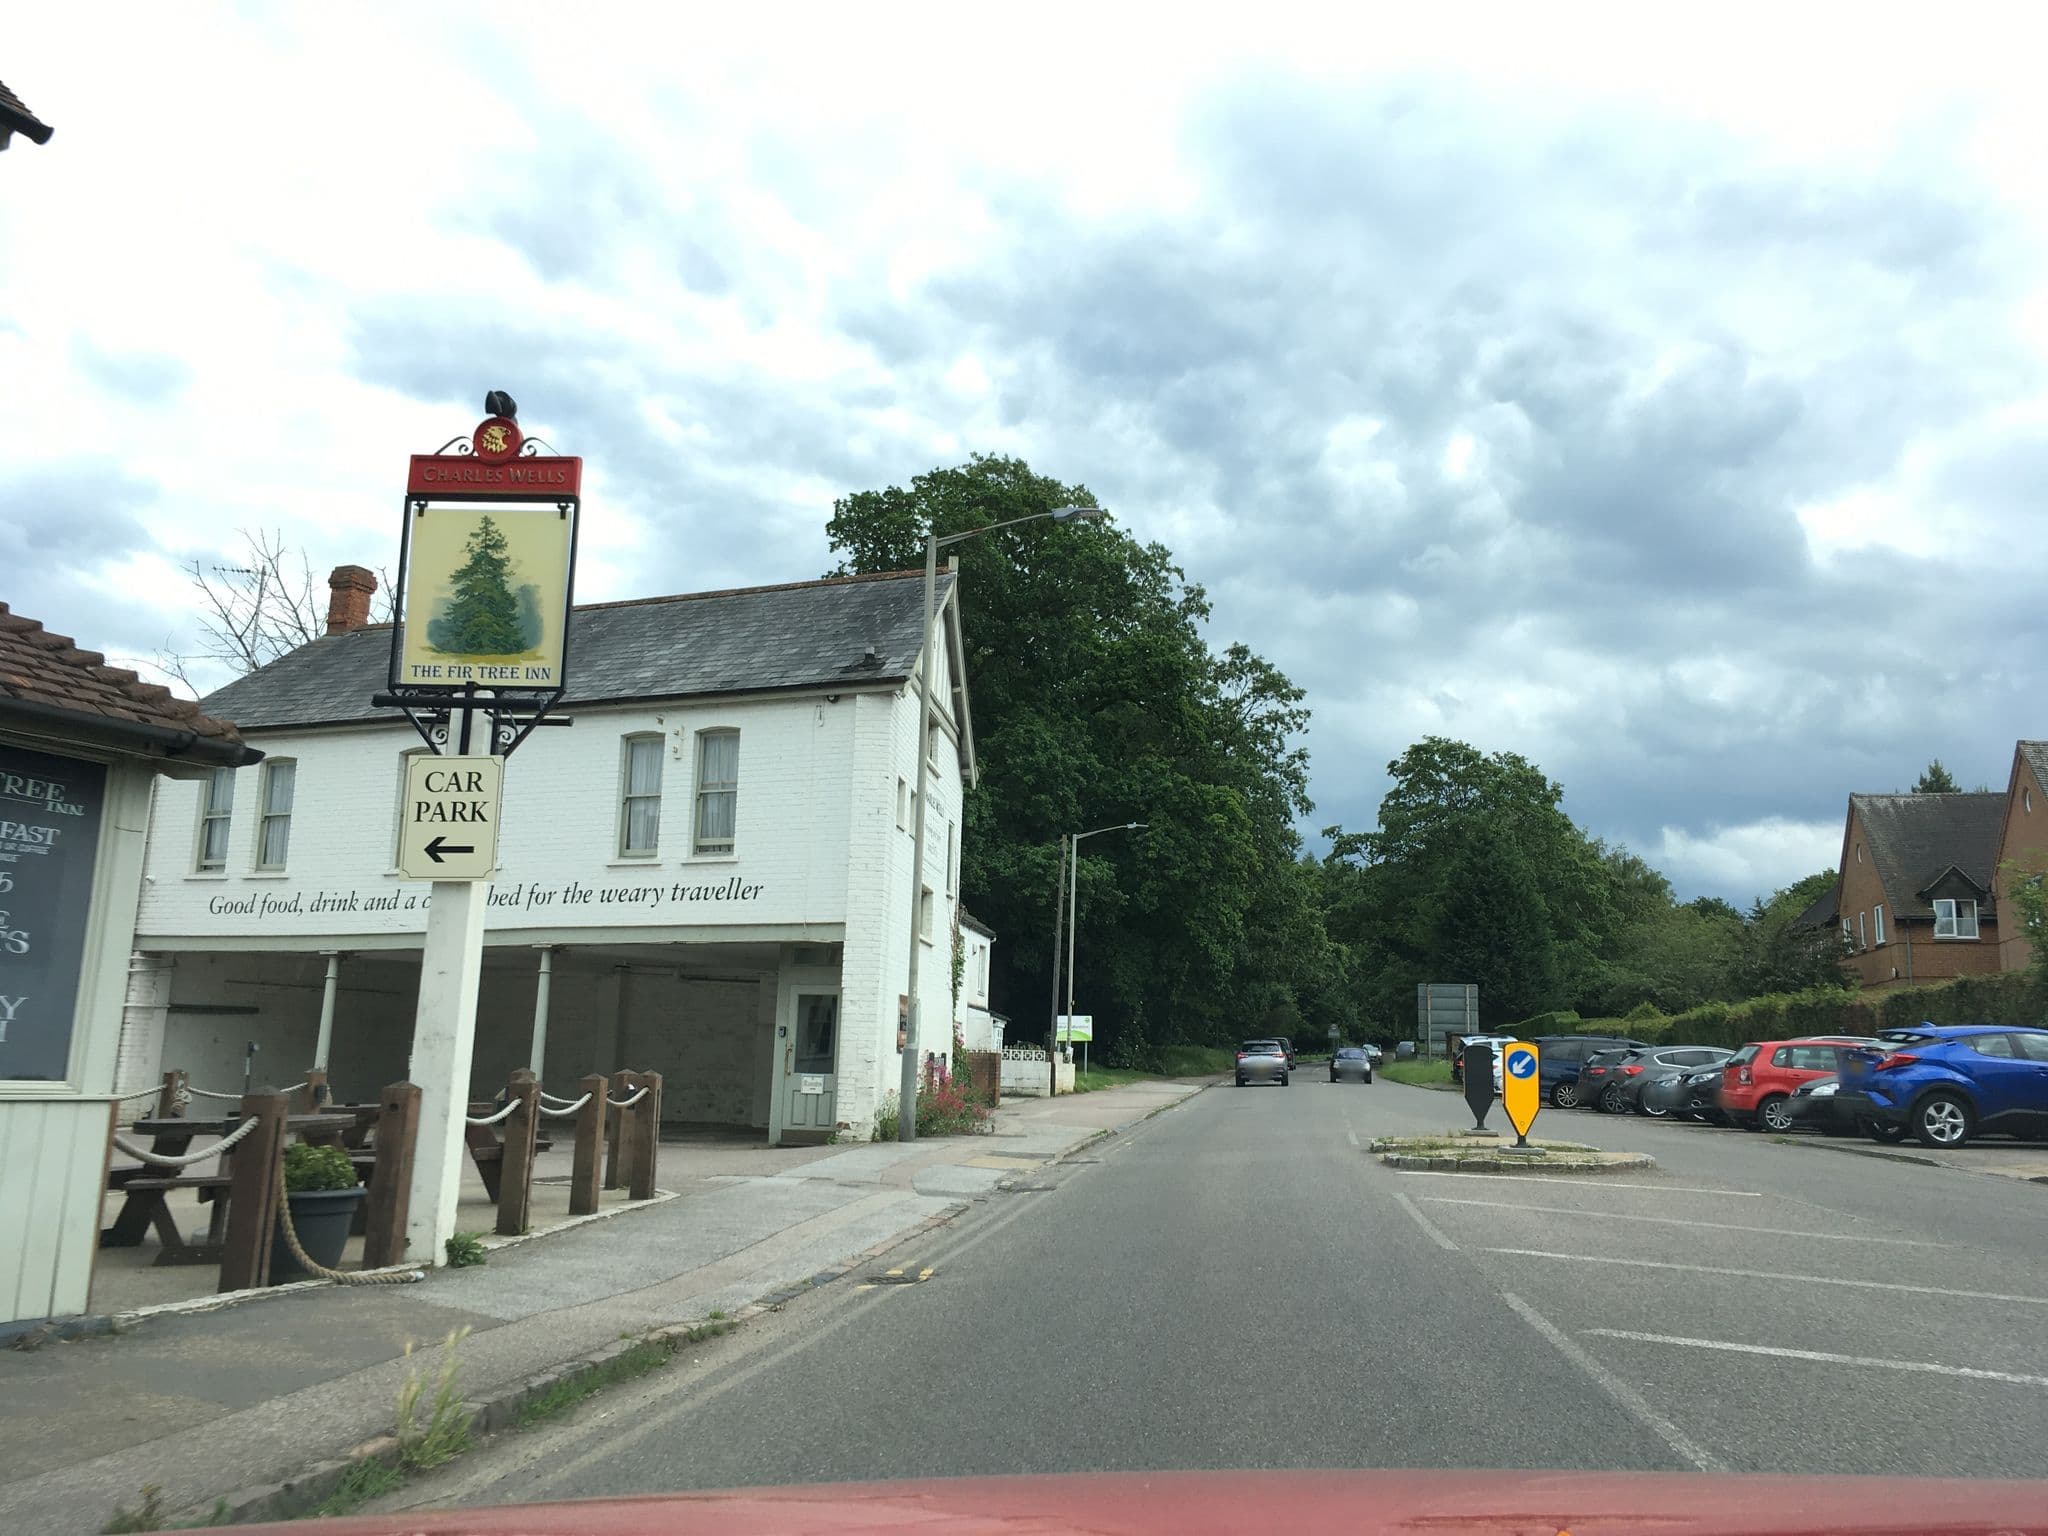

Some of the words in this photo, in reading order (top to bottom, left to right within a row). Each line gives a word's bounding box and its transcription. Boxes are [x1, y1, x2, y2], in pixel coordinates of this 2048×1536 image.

[423, 466, 503, 483] CHARLES
[509, 467, 566, 484] WELLS
[411, 664, 442, 678] THE
[447, 665, 473, 679] FIR
[478, 666, 520, 679] TREE
[525, 667, 551, 680] INN
[425, 771, 485, 793] CAR
[414, 801, 490, 823] PARK
[209, 893, 258, 915] Good
[259, 891, 304, 919] food,
[310, 891, 359, 913] drink
[364, 889, 401, 911] and
[404, 895, 417, 910] a
[486, 884, 523, 906] bed
[526, 883, 557, 911] for
[562, 882, 593, 904] the
[600, 887, 664, 908] weary
[671, 877, 764, 902] traveller
